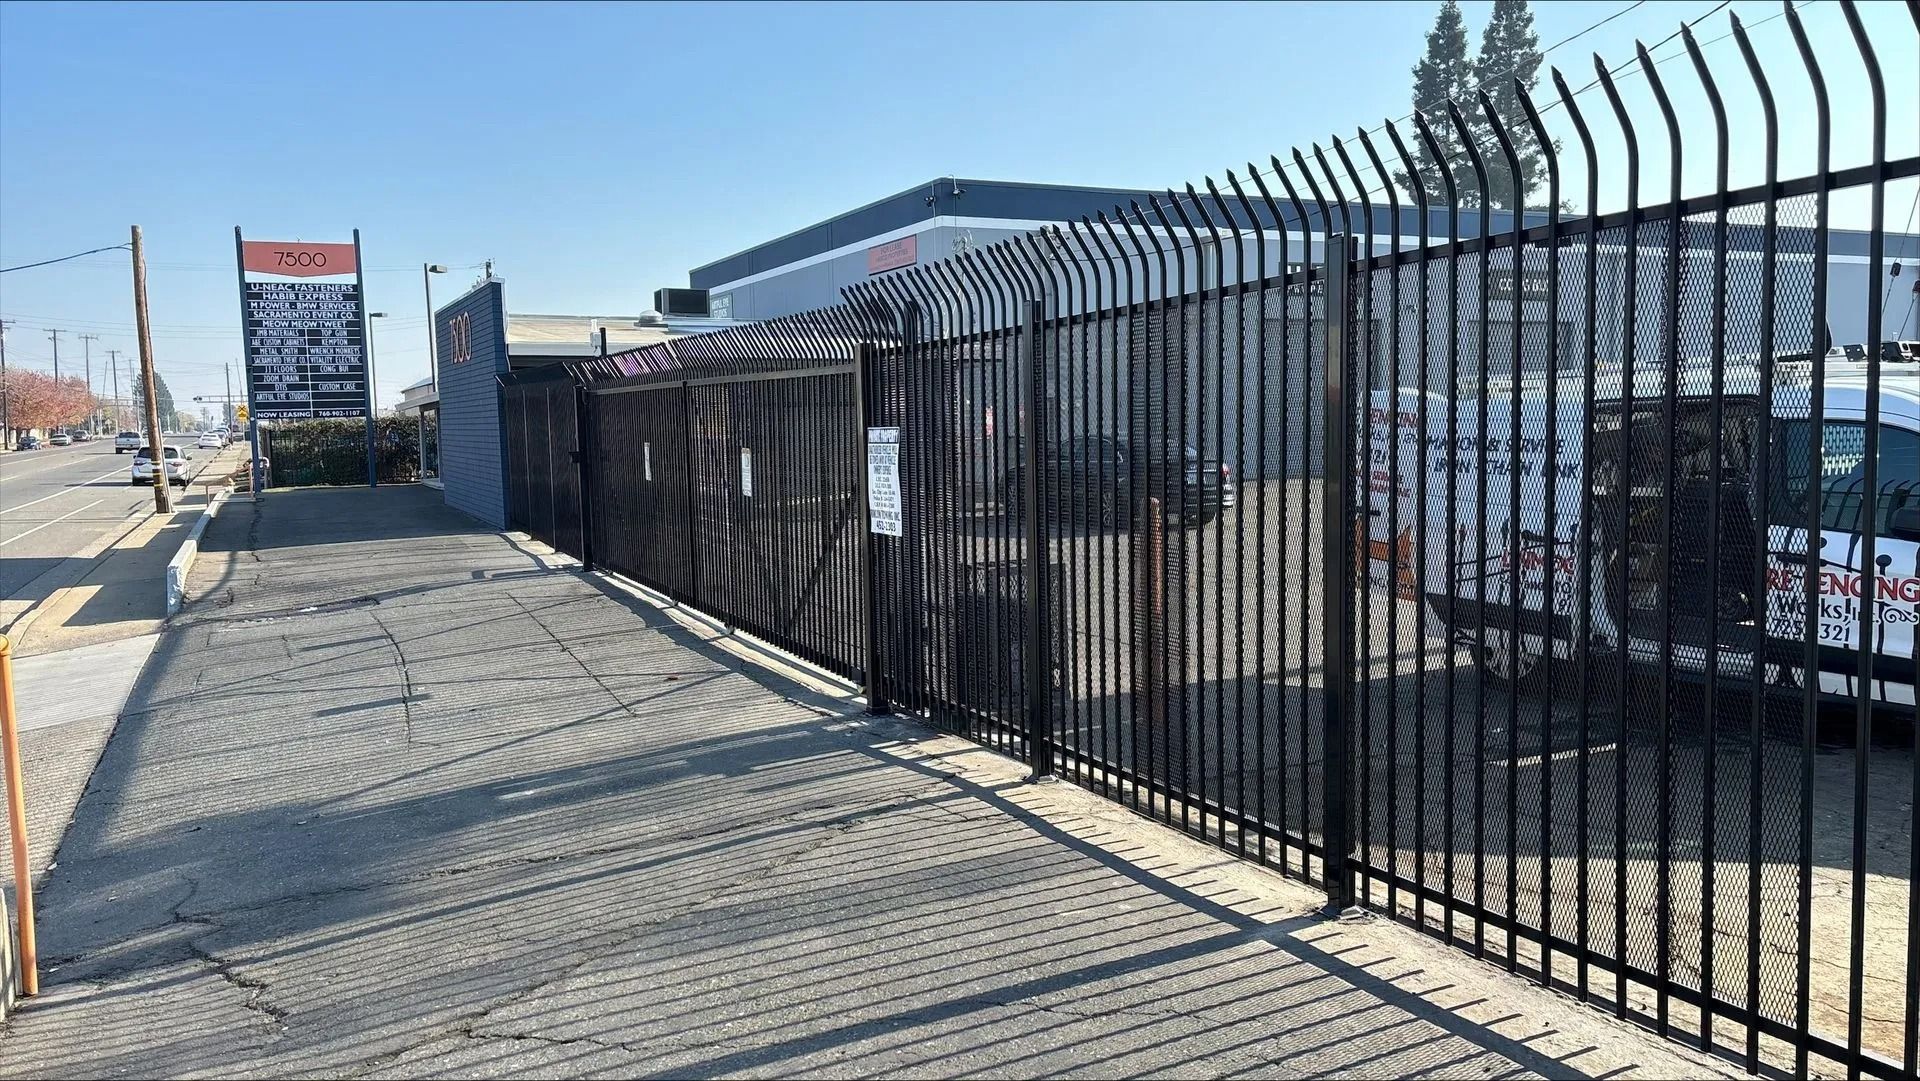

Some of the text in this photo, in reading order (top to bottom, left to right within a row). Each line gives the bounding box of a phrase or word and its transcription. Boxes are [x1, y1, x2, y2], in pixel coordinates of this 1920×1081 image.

[274, 251, 327, 268] 7500
[250, 283, 354, 292] U-NEAC FASTENERS
[262, 292, 344, 301] HABIB EXPRESS
[250, 301, 258, 309] M
[259, 301, 290, 309] POWER
[296, 302, 317, 310] BMW
[319, 302, 356, 310] SERVICES
[253, 310, 355, 320] SACRAMENTO EVENT CO.
[262, 320, 291, 328] MEOW
[291, 320, 319, 328] MEOW
[268, 329, 300, 337] MATERIALS
[321, 329, 348, 337] TOP GUN
[263, 338, 282, 346] CUSTOM
[283, 338, 305, 346] CABINETS
[321, 338, 349, 346] KEMPTON
[259, 347, 299, 355] METAL SMITH
[309, 347, 361, 355] WRENCH MONKEYS
[253, 356, 282, 364] SACRAMENTO
[283, 356, 298, 364] EVENT
[310, 356, 360, 364] VITALITY ELECTRIC
[273, 365, 298, 373] FLOORS
[319, 365, 349, 373] CONG BUI
[318, 382, 357, 391] CUSTOM CASE
[288, 392, 310, 400] STUDIOS
